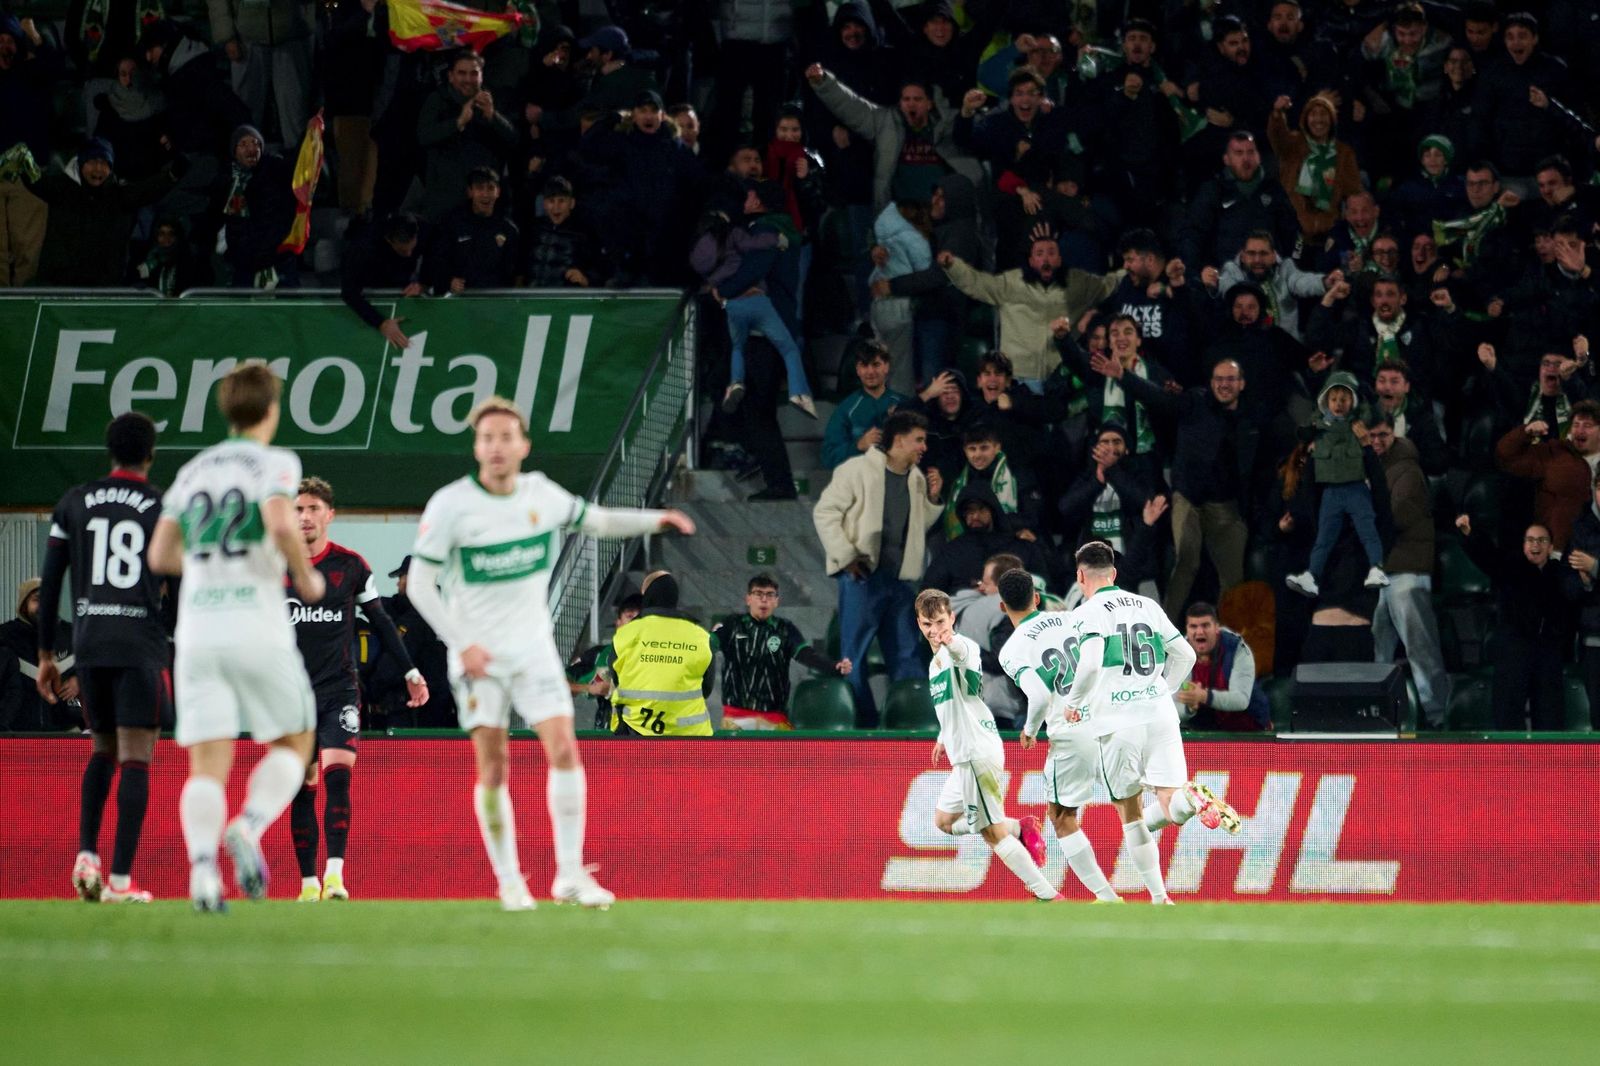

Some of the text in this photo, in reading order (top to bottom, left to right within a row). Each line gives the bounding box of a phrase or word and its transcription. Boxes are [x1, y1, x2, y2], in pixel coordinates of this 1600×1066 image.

[187, 487, 249, 560] 22
[85, 516, 145, 590] 18
[756, 551, 767, 563] 5
[1116, 596, 1143, 609] NETO
[288, 604, 343, 624] Midea
[1024, 617, 1063, 641] ÁLVARO
[641, 640, 698, 652] vectalia
[1116, 622, 1156, 677] 16
[640, 654, 684, 665] SEGURIDAD
[640, 707, 666, 735] 76
